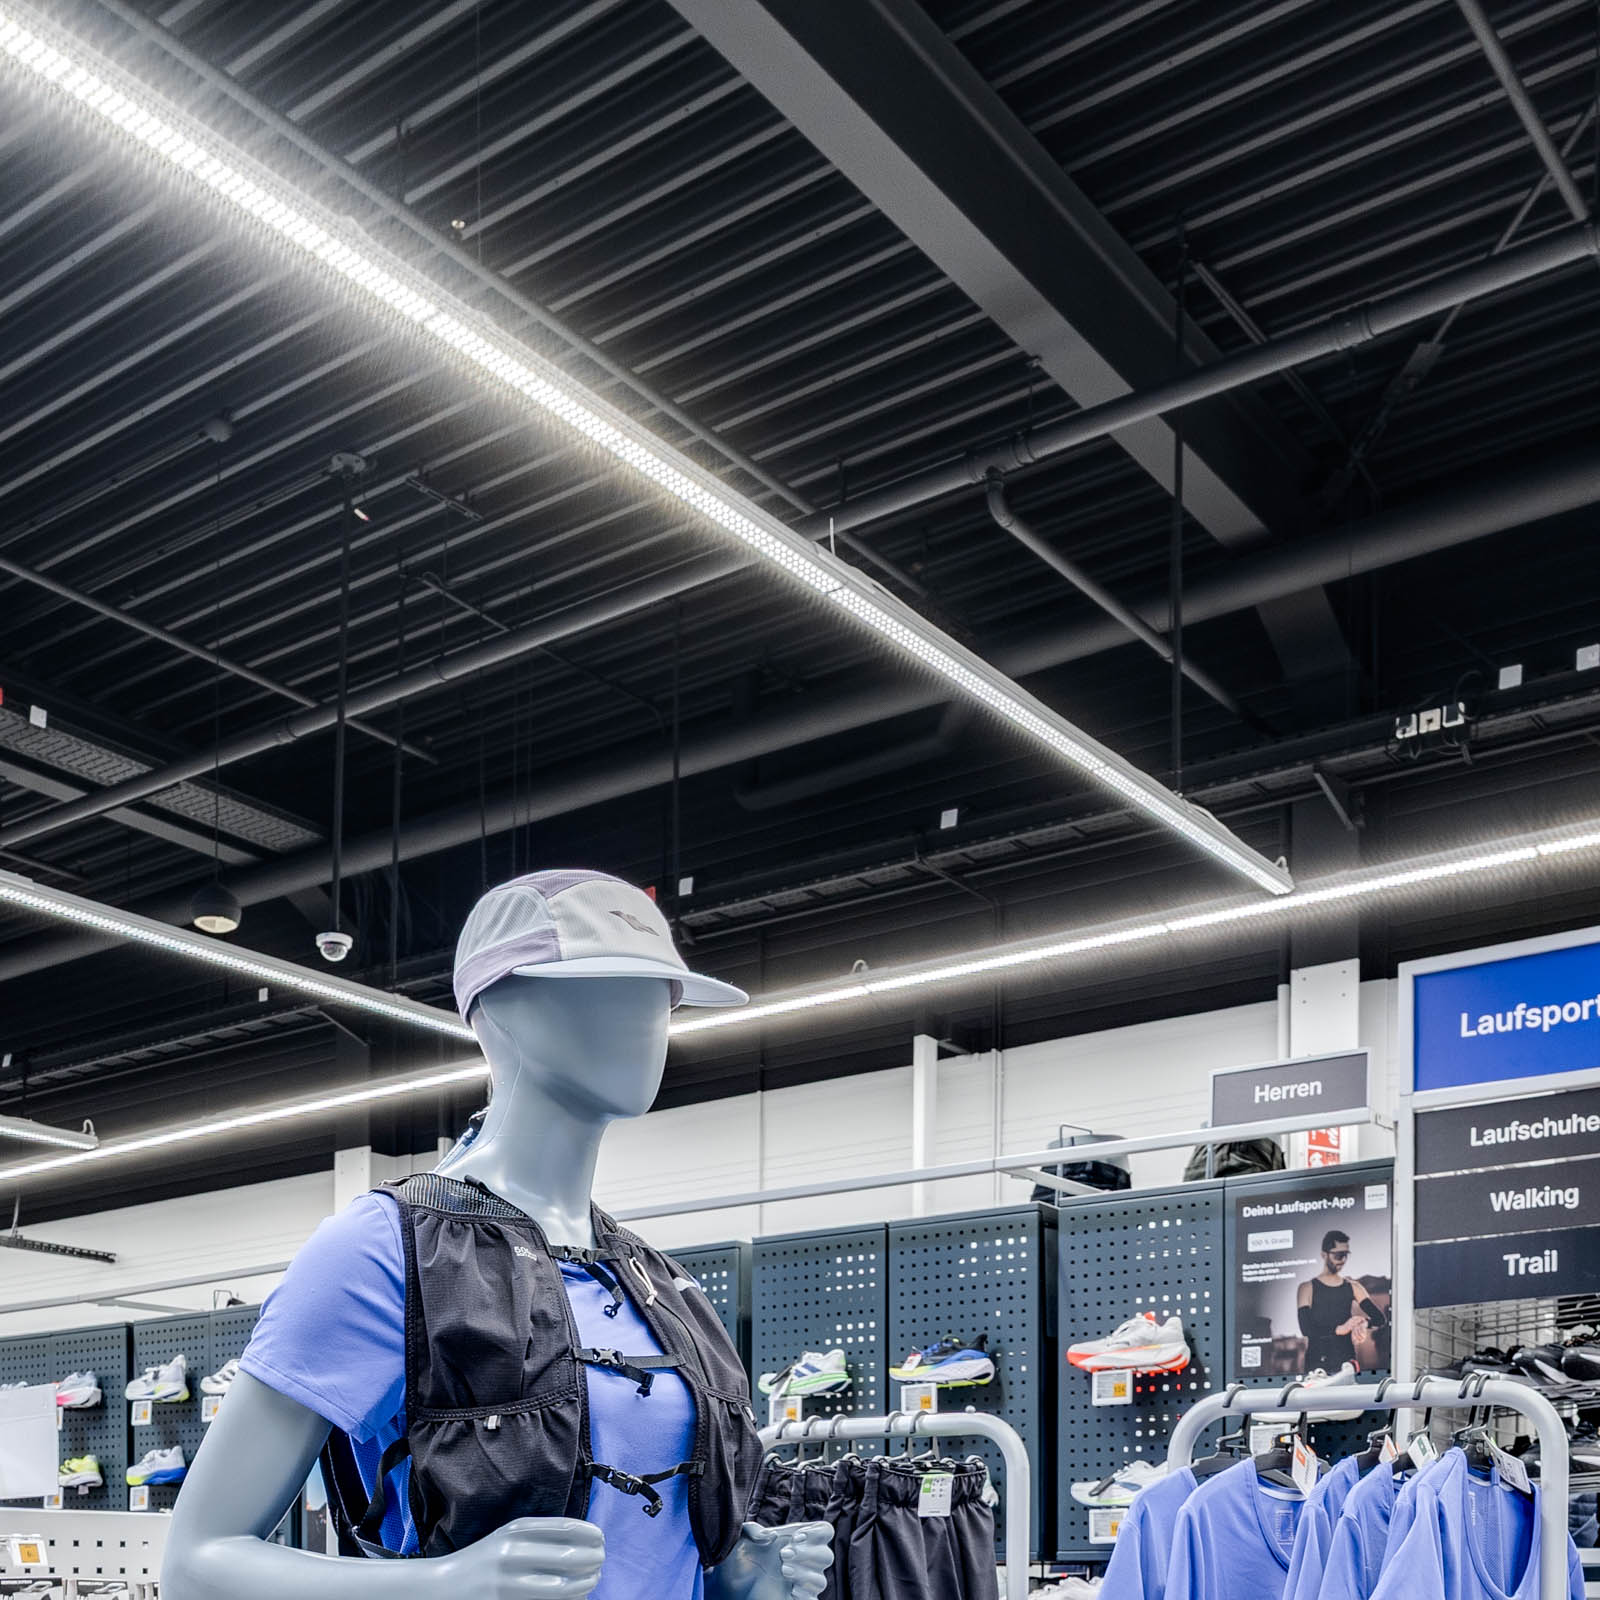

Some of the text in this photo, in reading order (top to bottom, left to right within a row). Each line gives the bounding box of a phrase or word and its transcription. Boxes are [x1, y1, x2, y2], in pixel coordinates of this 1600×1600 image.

[1254, 1080, 1322, 1103] Herren
[1470, 1113, 1600, 1147] Laufschuhe
[1242, 1203, 1274, 1218] Deine
[1274, 1196, 1355, 1215] Laufsport-App
[1490, 1185, 1579, 1213] Walking
[1503, 1249, 1558, 1276] Trail
